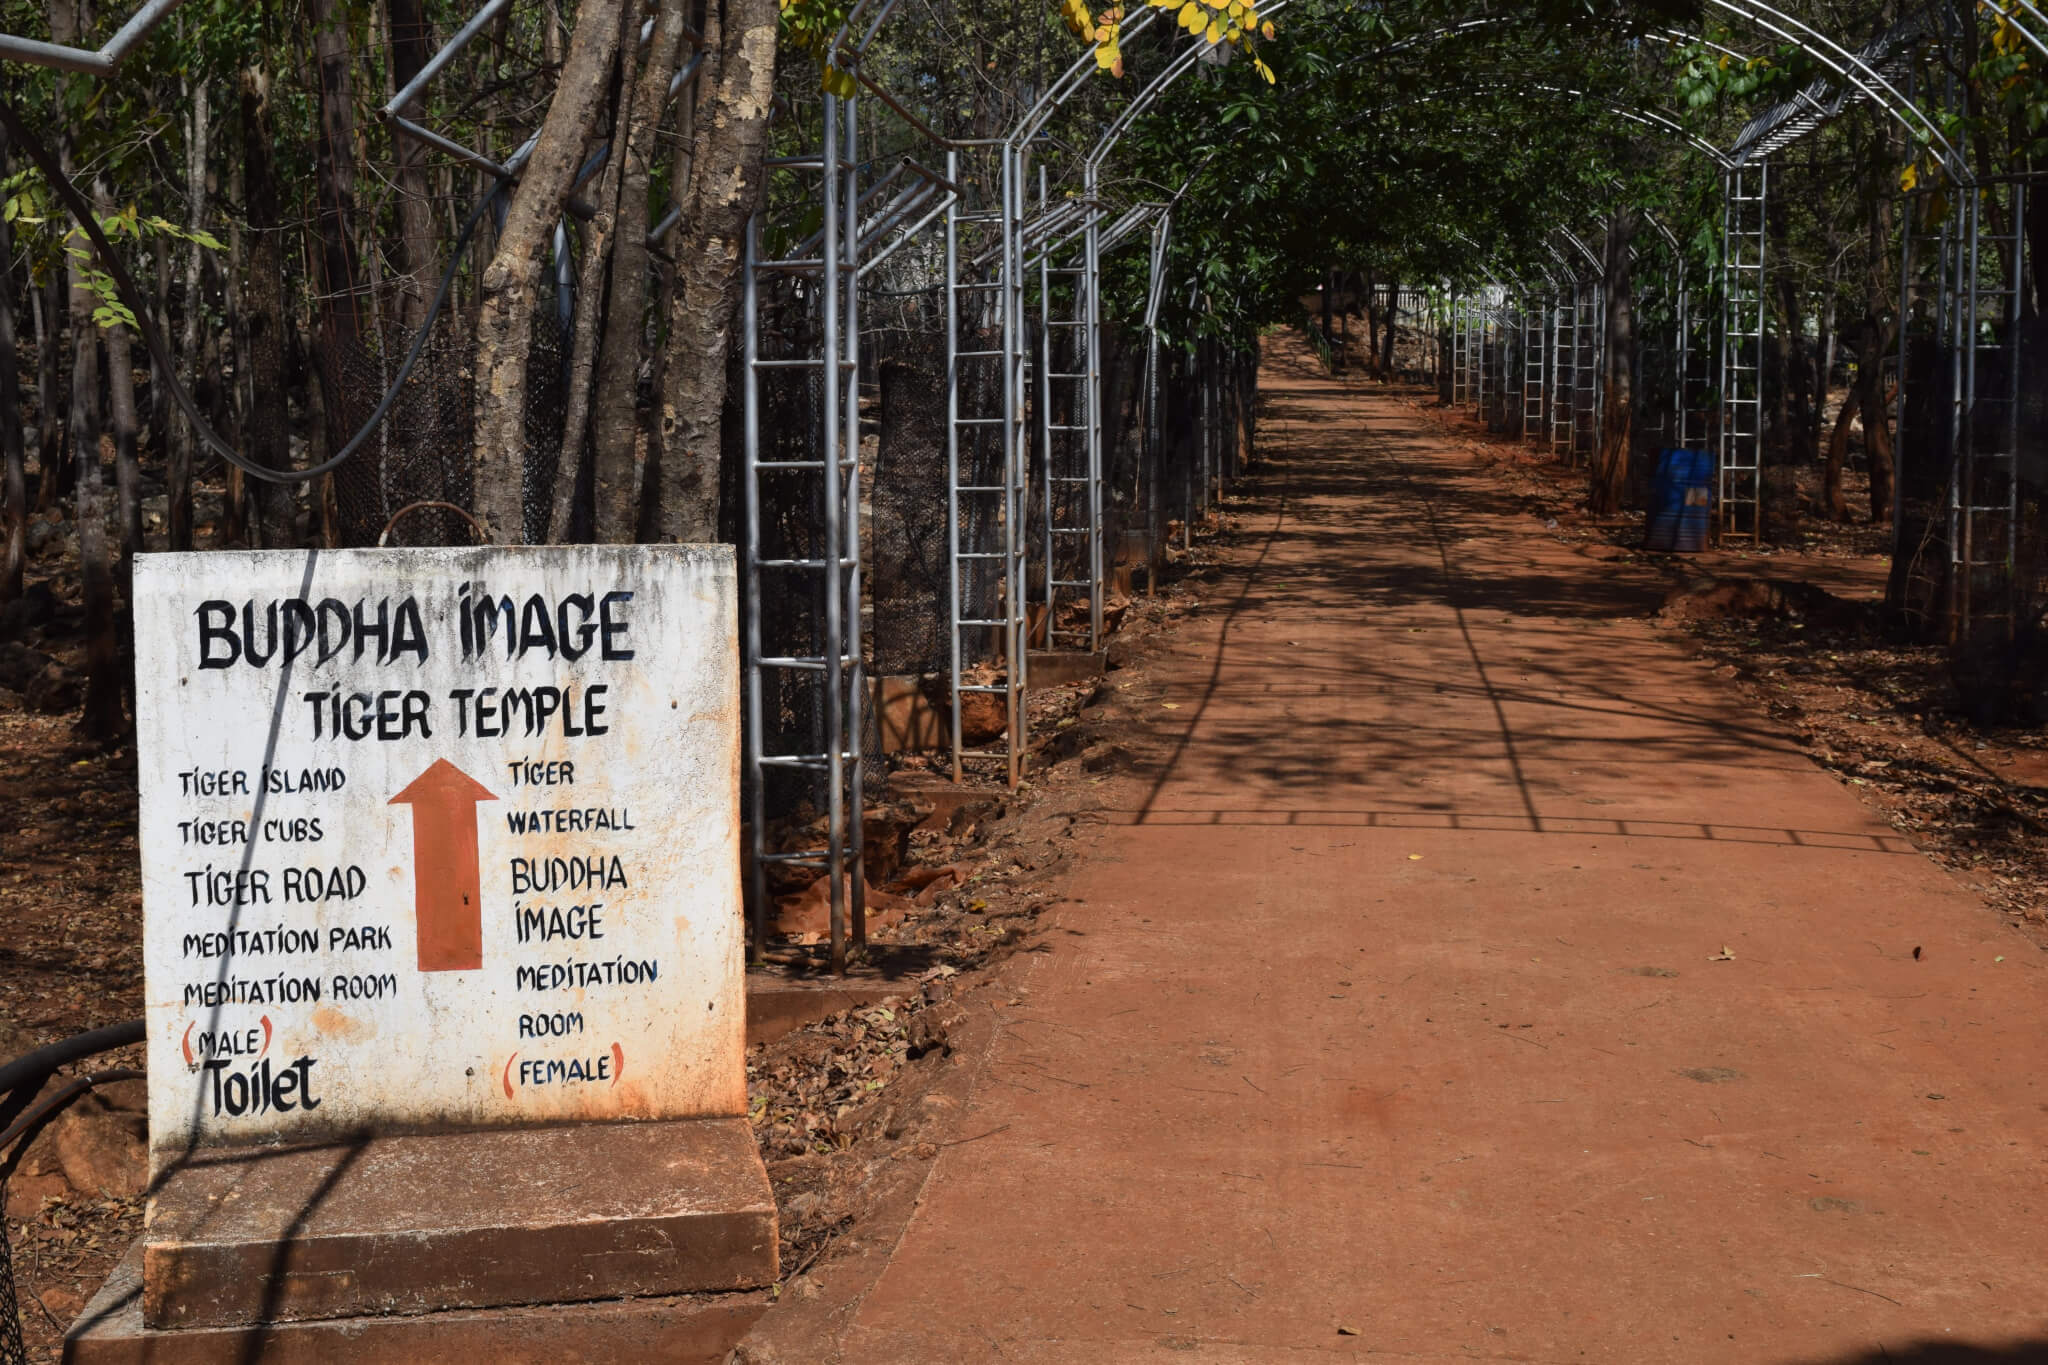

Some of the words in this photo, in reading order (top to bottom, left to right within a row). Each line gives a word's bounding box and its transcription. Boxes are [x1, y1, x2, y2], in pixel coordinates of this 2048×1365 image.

[194, 598, 428, 669] BUDDHA
[458, 581, 635, 665] IMAGE
[304, 681, 432, 742] TIGER
[449, 683, 609, 739] TEMPLE
[178, 766, 249, 796] TIGER
[262, 764, 346, 794] ISLAND
[508, 756, 575, 787] TIGER
[178, 817, 248, 845] TIGER
[264, 817, 324, 842] CUBS
[507, 808, 635, 835] WATERFALL
[184, 864, 272, 907] TIGER
[283, 865, 366, 904] ROAD
[510, 855, 628, 895] BUDDHA
[184, 923, 319, 959] MEDITATION
[330, 925, 392, 951] PARK
[514, 901, 604, 944] IMAGE
[184, 971, 320, 1008] MEDITATION
[333, 973, 398, 1001] ROOM
[516, 954, 658, 991] MEDITATION
[182, 1015, 272, 1065] (MALE)
[518, 1012, 584, 1039] ROOM
[204, 1055, 321, 1118] Toilet
[503, 1041, 624, 1100] (FEMALE)
